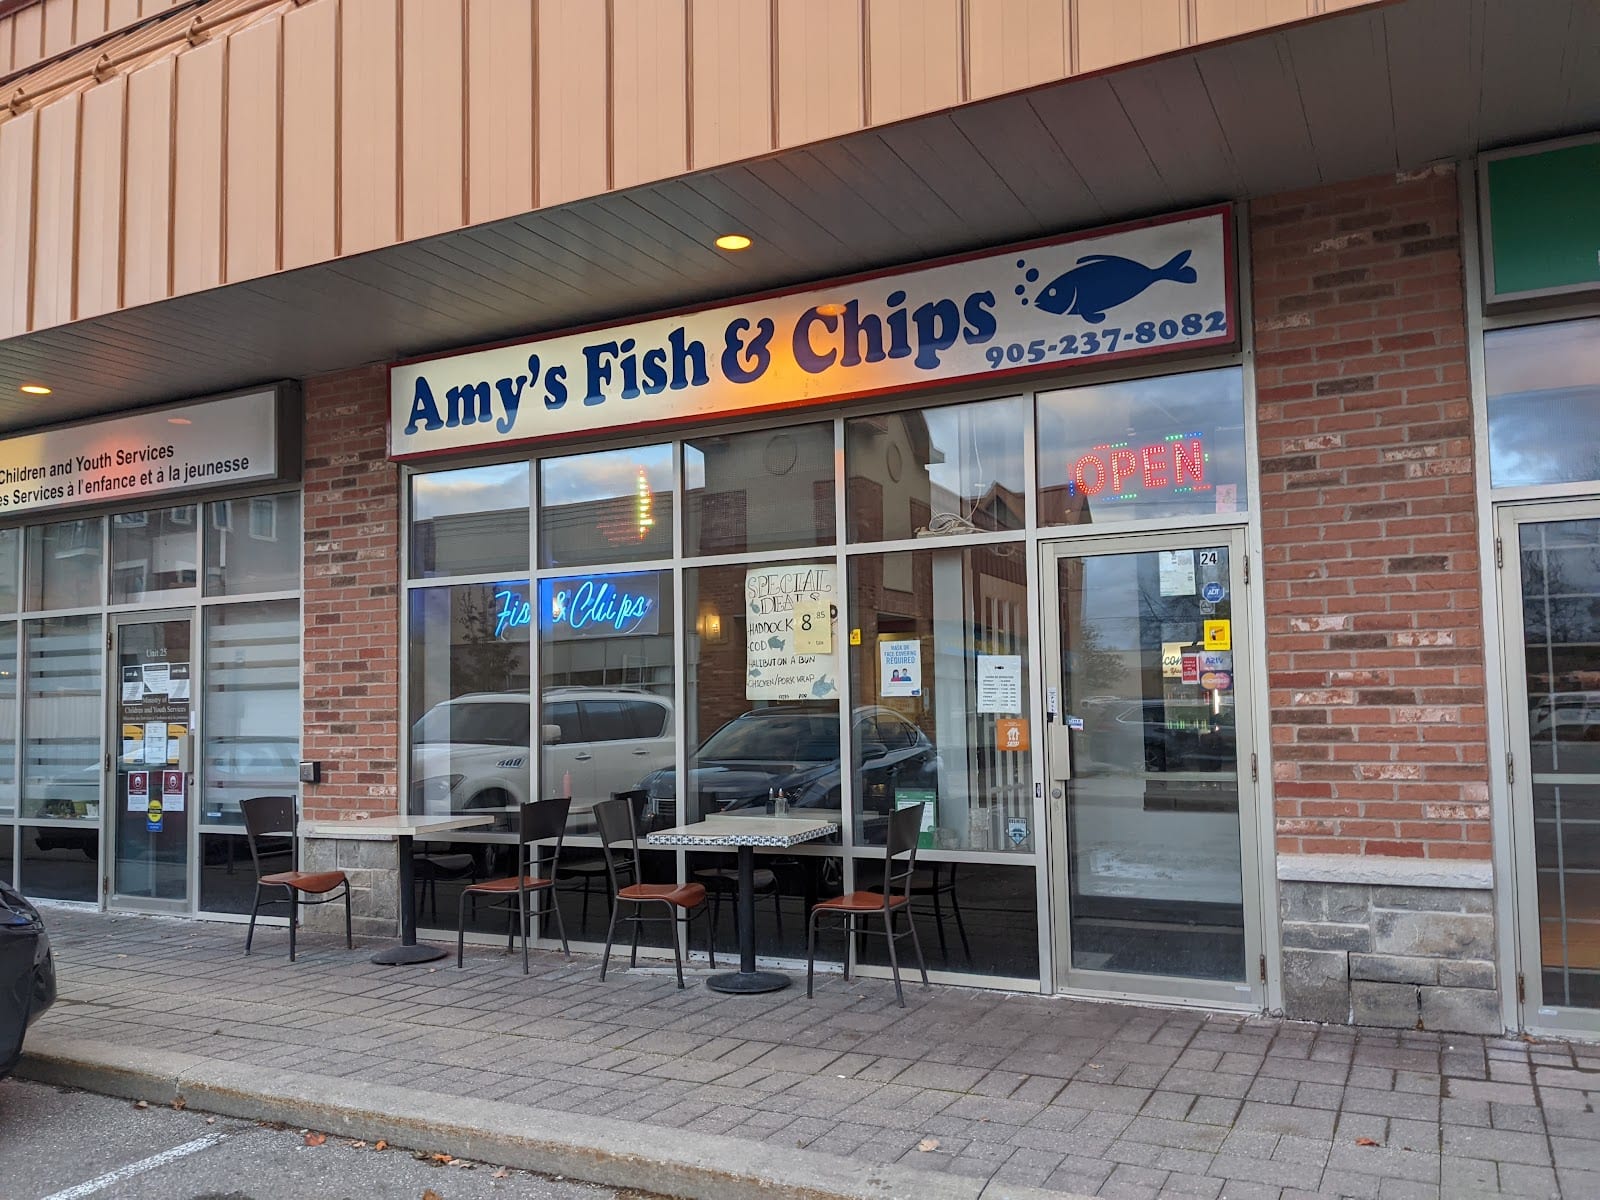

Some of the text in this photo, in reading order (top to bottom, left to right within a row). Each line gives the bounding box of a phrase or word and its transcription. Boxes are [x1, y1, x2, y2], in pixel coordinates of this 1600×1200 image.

[985, 311, 1227, 369] 905-237-8082
[404, 290, 997, 435] Amy's Fish & Chips
[50, 459, 73, 476] and
[75, 452, 112, 471] Youth
[116, 445, 175, 465] Services
[1075, 440, 1202, 496] OPEN
[0, 456, 250, 507] es Services à l'enfance et à la jeunesse
[1201, 553, 1217, 565] 24
[747, 569, 832, 598] SPECIAL
[1207, 588, 1220, 596] ADT
[495, 590, 532, 638] Fis
[570, 580, 646, 630] Chips
[749, 618, 794, 637] HADDOCK
[160, 648, 168, 656] 25
[750, 640, 768, 652] COD
[798, 656, 816, 664] BUN
[886, 657, 916, 665] REQUIRED
